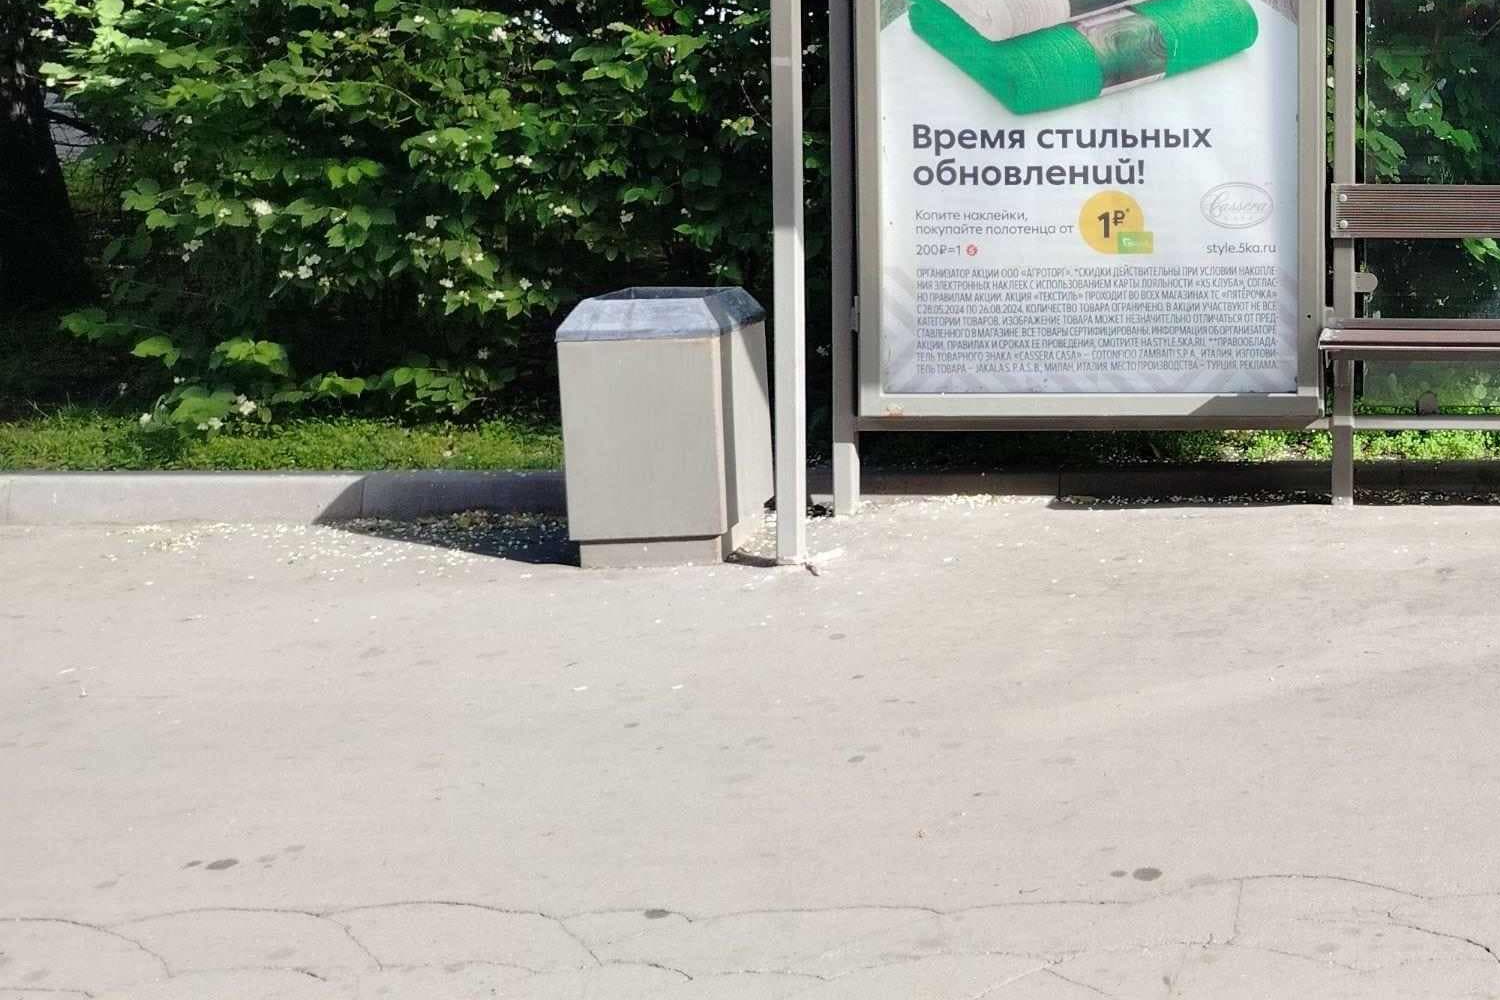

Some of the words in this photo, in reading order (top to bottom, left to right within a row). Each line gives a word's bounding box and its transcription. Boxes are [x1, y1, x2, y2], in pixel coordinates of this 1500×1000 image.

[912, 123, 1025, 156] Время
[1036, 127, 1212, 149] стильных
[912, 158, 1145, 186] обновлений!
[915, 209, 960, 221] Копите
[963, 209, 1028, 223] наклейки,
[915, 223, 985, 237] покупайте
[985, 224, 1056, 236] полотенца
[1059, 224, 1074, 234] от
[1206, 241, 1277, 257] style.5ka.ru
[916, 268, 970, 279] ОРГАНИЗАТОР
[972, 268, 998, 278] АКЦИИ
[1001, 268, 1018, 278] ООО
[1113, 267, 1180, 277] ДЕЙСТВИТЕЛЬНЫ
[1182, 267, 1198, 277] ПРИ
[1200, 267, 1238, 277] УСЛОВИИ
[916, 280, 932, 290] НИЯ
[933, 280, 990, 290] ЭЛЕКТРОННЫХ
[992, 279, 1028, 289] НАКЛЕЕК
[1036, 279, 1112, 289] ИСПОЛЬЗОВАНИЕМ
[1114, 279, 1140, 289] КАРТЫ
[1142, 278, 1193, 288] ЛОЯЛЬНОСТИ
[916, 292, 929, 302] НО
[930, 292, 972, 302] ПРАВИЛАМ
[1005, 291, 1032, 301] АКЦИЯ
[1085, 290, 1127, 301] ПРОХОДИТ
[1129, 290, 1138, 300] ВО
[1140, 290, 1159, 300] ВСЕХ
[1161, 290, 1208, 300] МАГАЗИНАХ
[966, 303, 977, 313] ПО
[1025, 303, 1078, 313] КОЛИЧЕСТВО
[1080, 303, 1110, 313] ТОВАРА
[1174, 302, 1201, 312] АКЦИИ
[1202, 302, 1249, 312] УЧАСТВУЮТ
[1251, 302, 1260, 312] НЕ
[1262, 302, 1276, 312] ВСЕ
[1002, 315, 1061, 326] ИЗОБРАЖЕНИЕ
[1063, 315, 1093, 325] ТОВАРА
[1095, 315, 1123, 325] МОЖЕТ
[1126, 314, 1191, 324] НЕЗНАЧИТЕЛЬНО
[1193, 314, 1242, 324] ОТЛИЧАТЬСЯ
[1244, 314, 1254, 324] ОТ
[947, 340, 989, 350] ПРАВИЛАХ
[999, 339, 1030, 349] СРОКАХ
[1097, 338, 1138, 348] СМОТРИТЕ
[985, 351, 1010, 361] ЗНАКА
[937, 364, 966, 374] ТОВАРА
